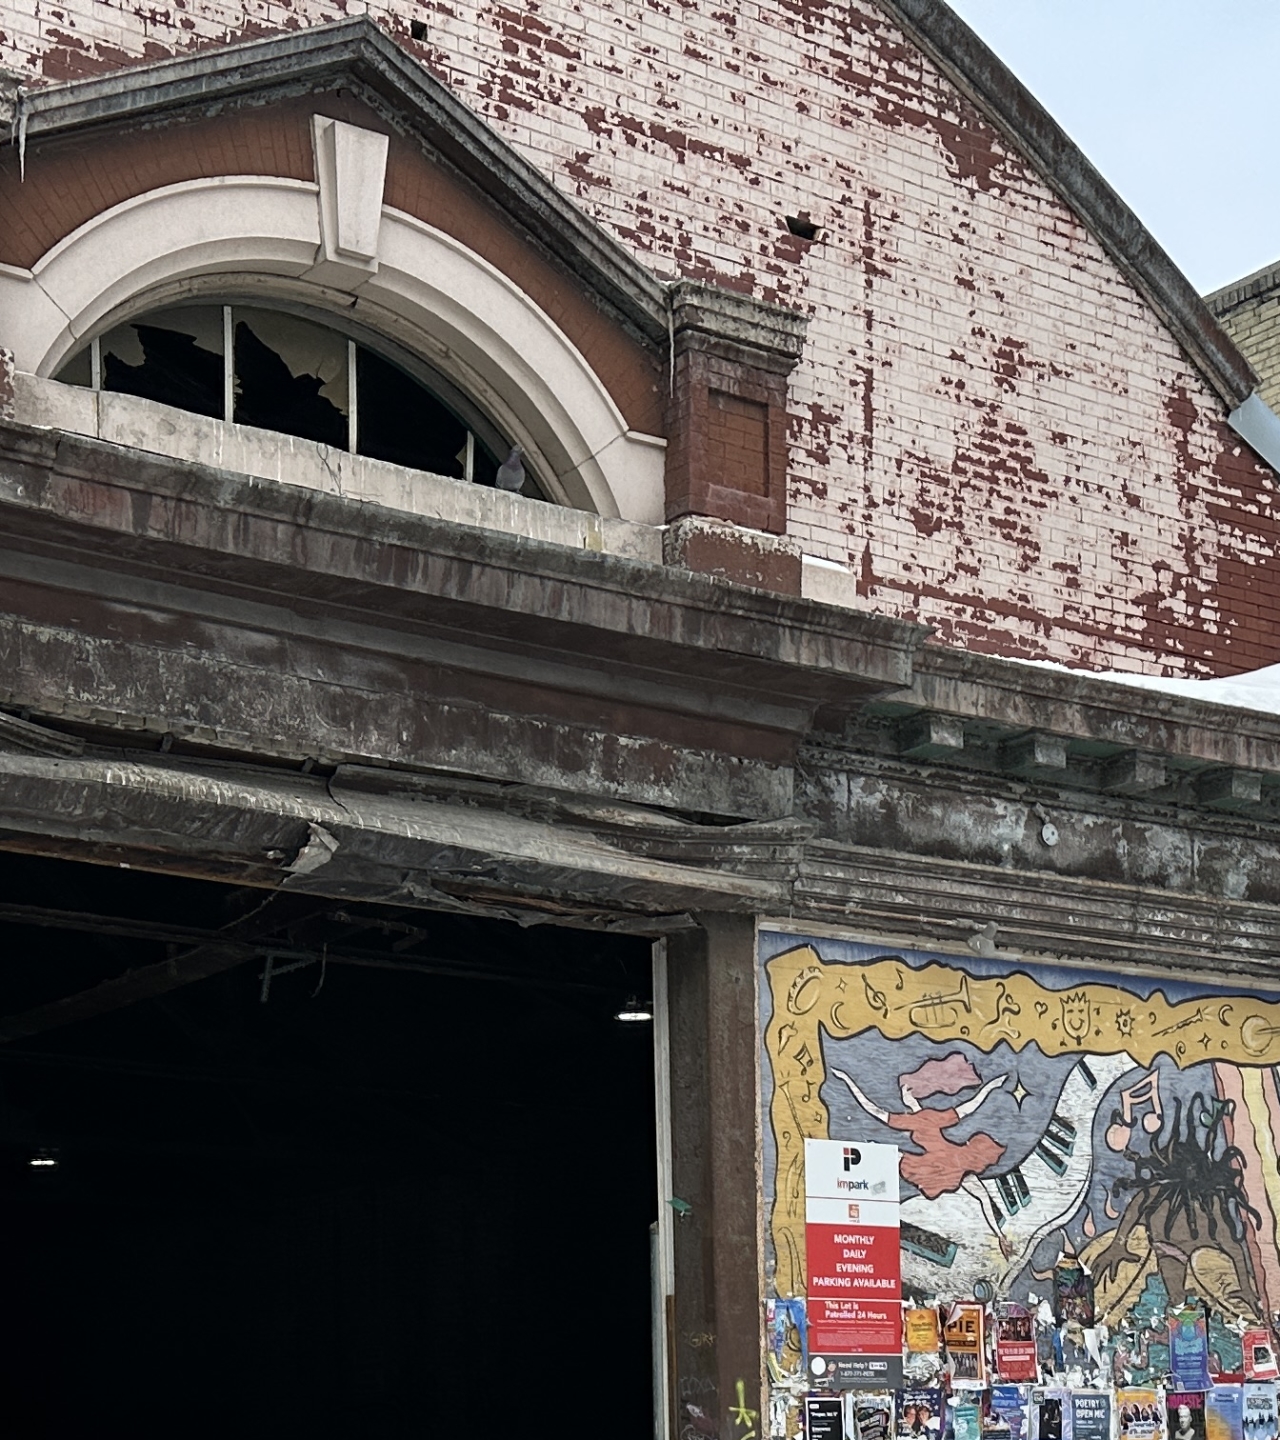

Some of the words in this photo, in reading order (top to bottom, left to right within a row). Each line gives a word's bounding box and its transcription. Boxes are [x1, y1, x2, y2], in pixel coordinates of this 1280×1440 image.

[837, 1177, 869, 1191] impark
[834, 1234, 874, 1245] MONTHLY
[843, 1249, 866, 1259] DAILY
[836, 1263, 874, 1274] EVENING
[813, 1277, 851, 1287] PARKING
[853, 1278, 896, 1289] AVAILABLE
[825, 1301, 838, 1310] This
[840, 1301, 852, 1310] Lot
[853, 1302, 859, 1310] is
[825, 1310, 856, 1319] Patrolled
[857, 1311, 866, 1319] 24
[868, 1312, 887, 1320] Hours
[1075, 1399, 1099, 1409] POETRY
[1076, 1409, 1093, 1419] OPEN
